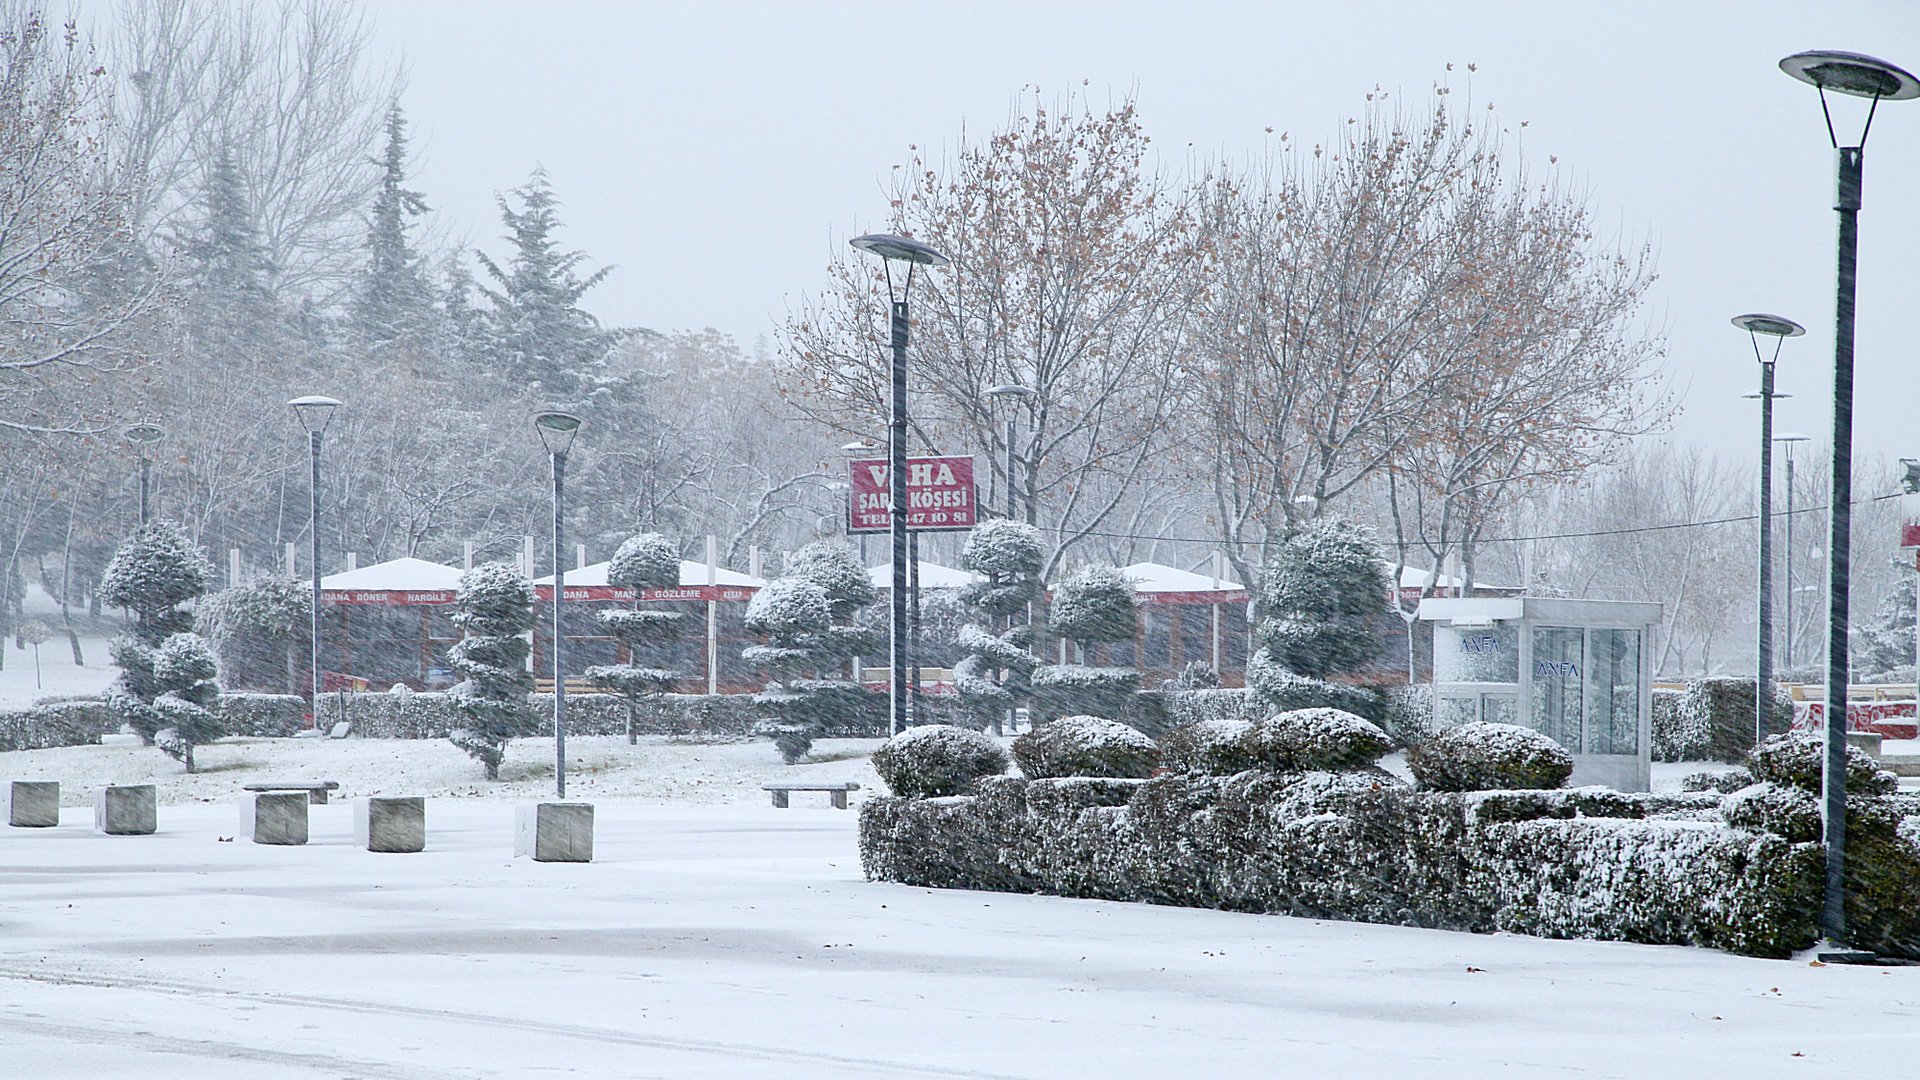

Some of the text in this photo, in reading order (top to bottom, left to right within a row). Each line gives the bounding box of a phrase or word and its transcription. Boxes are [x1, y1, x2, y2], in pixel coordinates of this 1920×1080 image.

[868, 463, 956, 488] VHA
[858, 486, 967, 513] ŞAR KÖŞESİ
[931, 512, 948, 523] 10
[356, 591, 388, 601] DÖNER
[407, 592, 447, 601] NARGİLE
[563, 591, 590, 599] DANA
[614, 590, 646, 599] MAN
[1460, 635, 1500, 653] ANFA
[1536, 660, 1579, 678] ANFA
